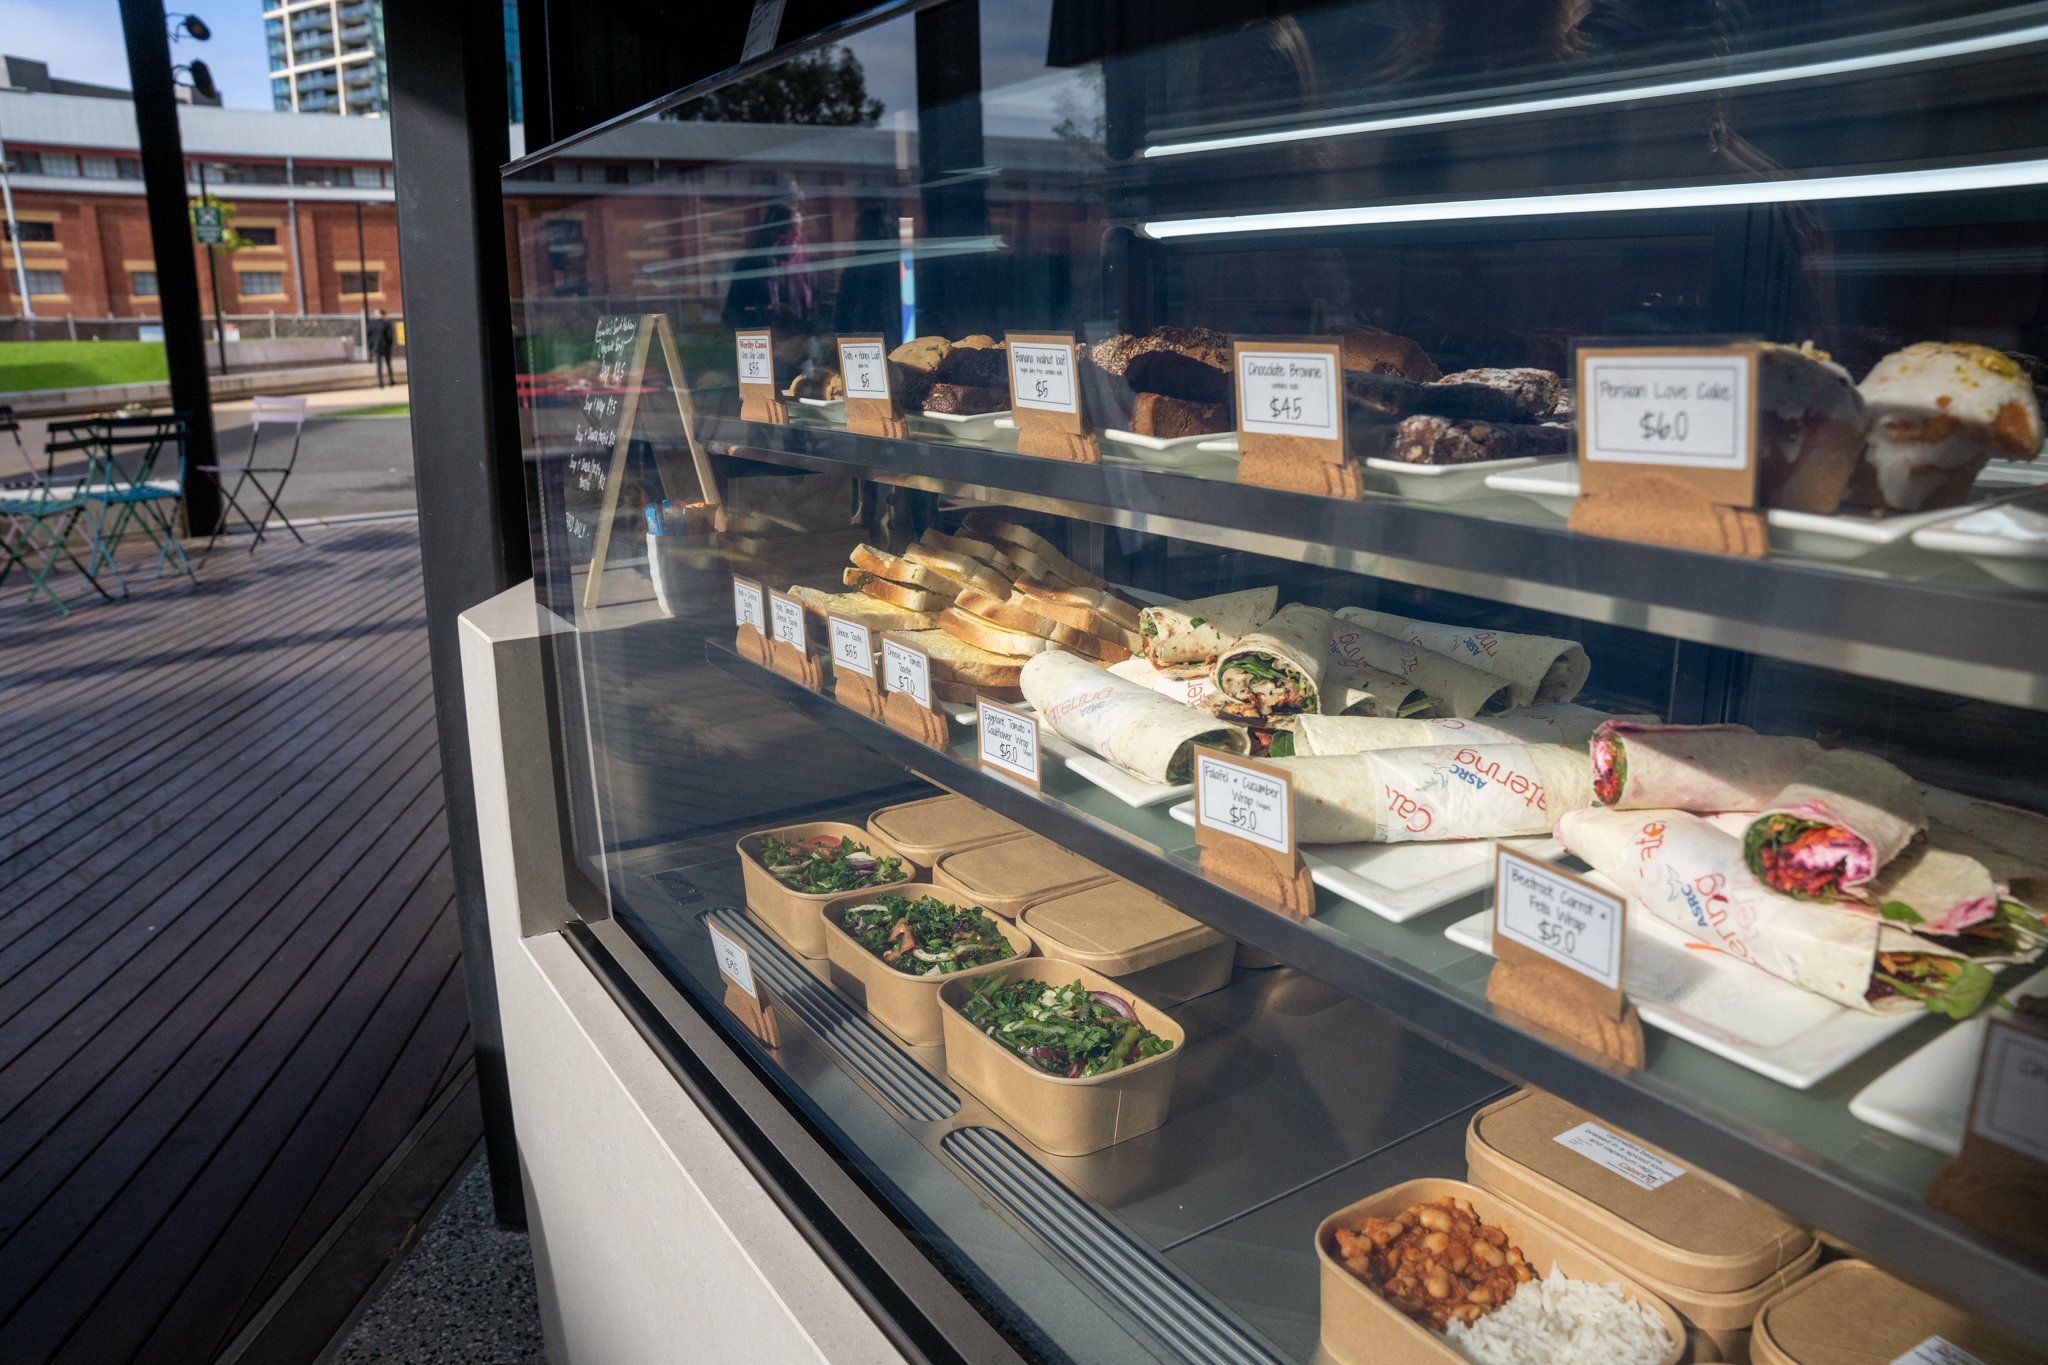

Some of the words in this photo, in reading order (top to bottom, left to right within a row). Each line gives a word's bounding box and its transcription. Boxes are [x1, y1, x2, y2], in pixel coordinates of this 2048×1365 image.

[739, 341, 754, 351] Worthy
[754, 340, 767, 349] Cause
[1015, 351, 1034, 364] Banana
[1248, 361, 1286, 378] Chocolate
[1289, 363, 1323, 379] Brownie
[1036, 379, 1049, 399] $5
[1600, 379, 1648, 400] Persian
[1653, 381, 1690, 401] Love
[1696, 380, 1732, 402] Cake
[836, 627, 850, 639] Cheese
[850, 631, 863, 643] Toastie
[887, 646, 902, 661] Cheese
[1463, 636, 1481, 656] ASRC
[898, 662, 912, 676] Toastie
[1007, 719, 1025, 734] Tomato
[1015, 734, 1030, 749] Wrap
[1205, 765, 1229, 783] Falafel
[1242, 777, 1280, 799] Cucumber
[1448, 763, 1488, 790] ASRC
[1232, 788, 1254, 810] Wrap
[1559, 890, 1595, 916] Carrot
[1681, 884, 1709, 927] ASRC
[1529, 895, 1551, 916] Feta
[1556, 906, 1588, 935] Wrap
